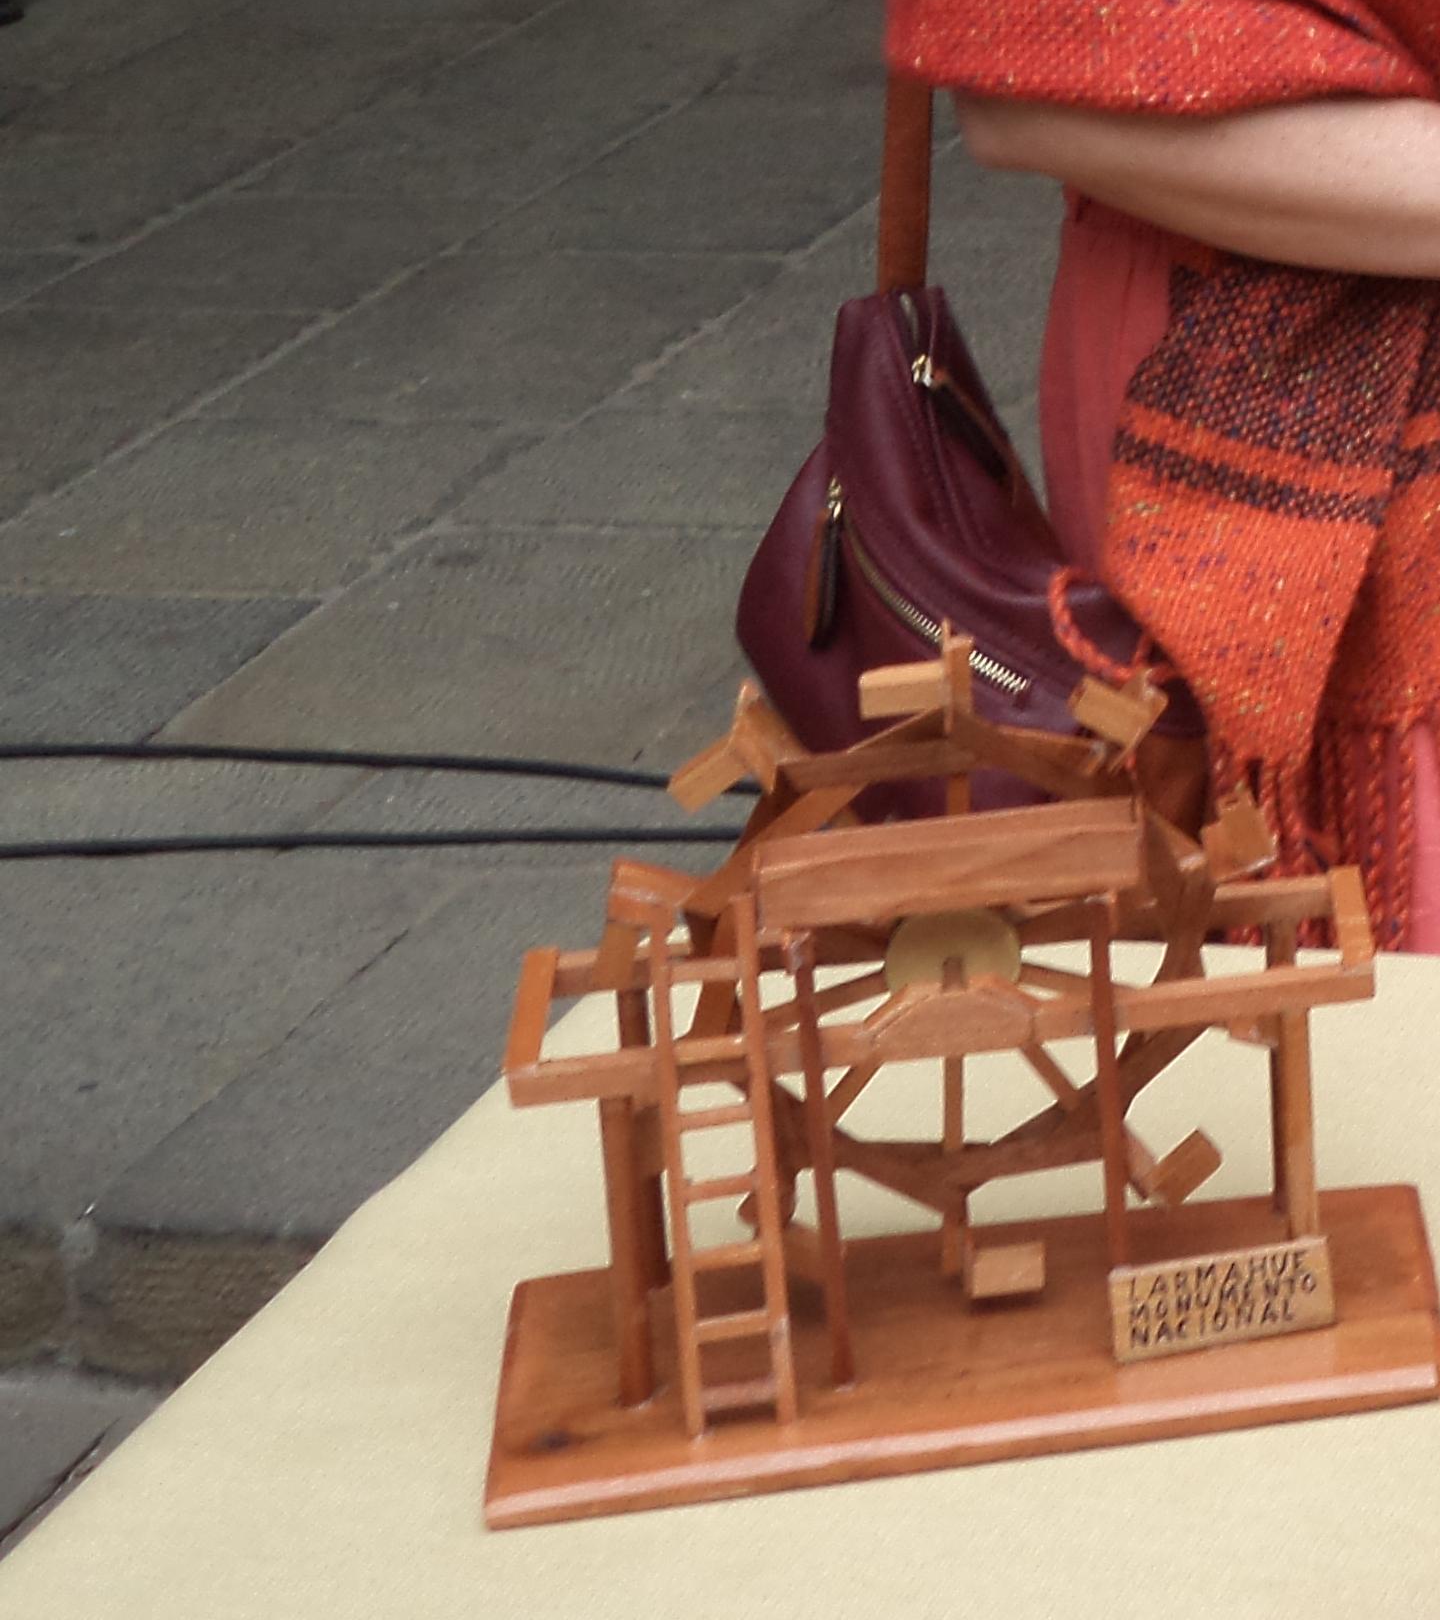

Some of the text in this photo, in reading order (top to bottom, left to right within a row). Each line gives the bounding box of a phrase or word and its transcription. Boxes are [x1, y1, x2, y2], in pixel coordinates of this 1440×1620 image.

[1129, 1250, 1307, 1300] LARMAHUE
[1129, 1273, 1317, 1325] MONUMENTO
[1130, 1301, 1294, 1347] NACIONAL
